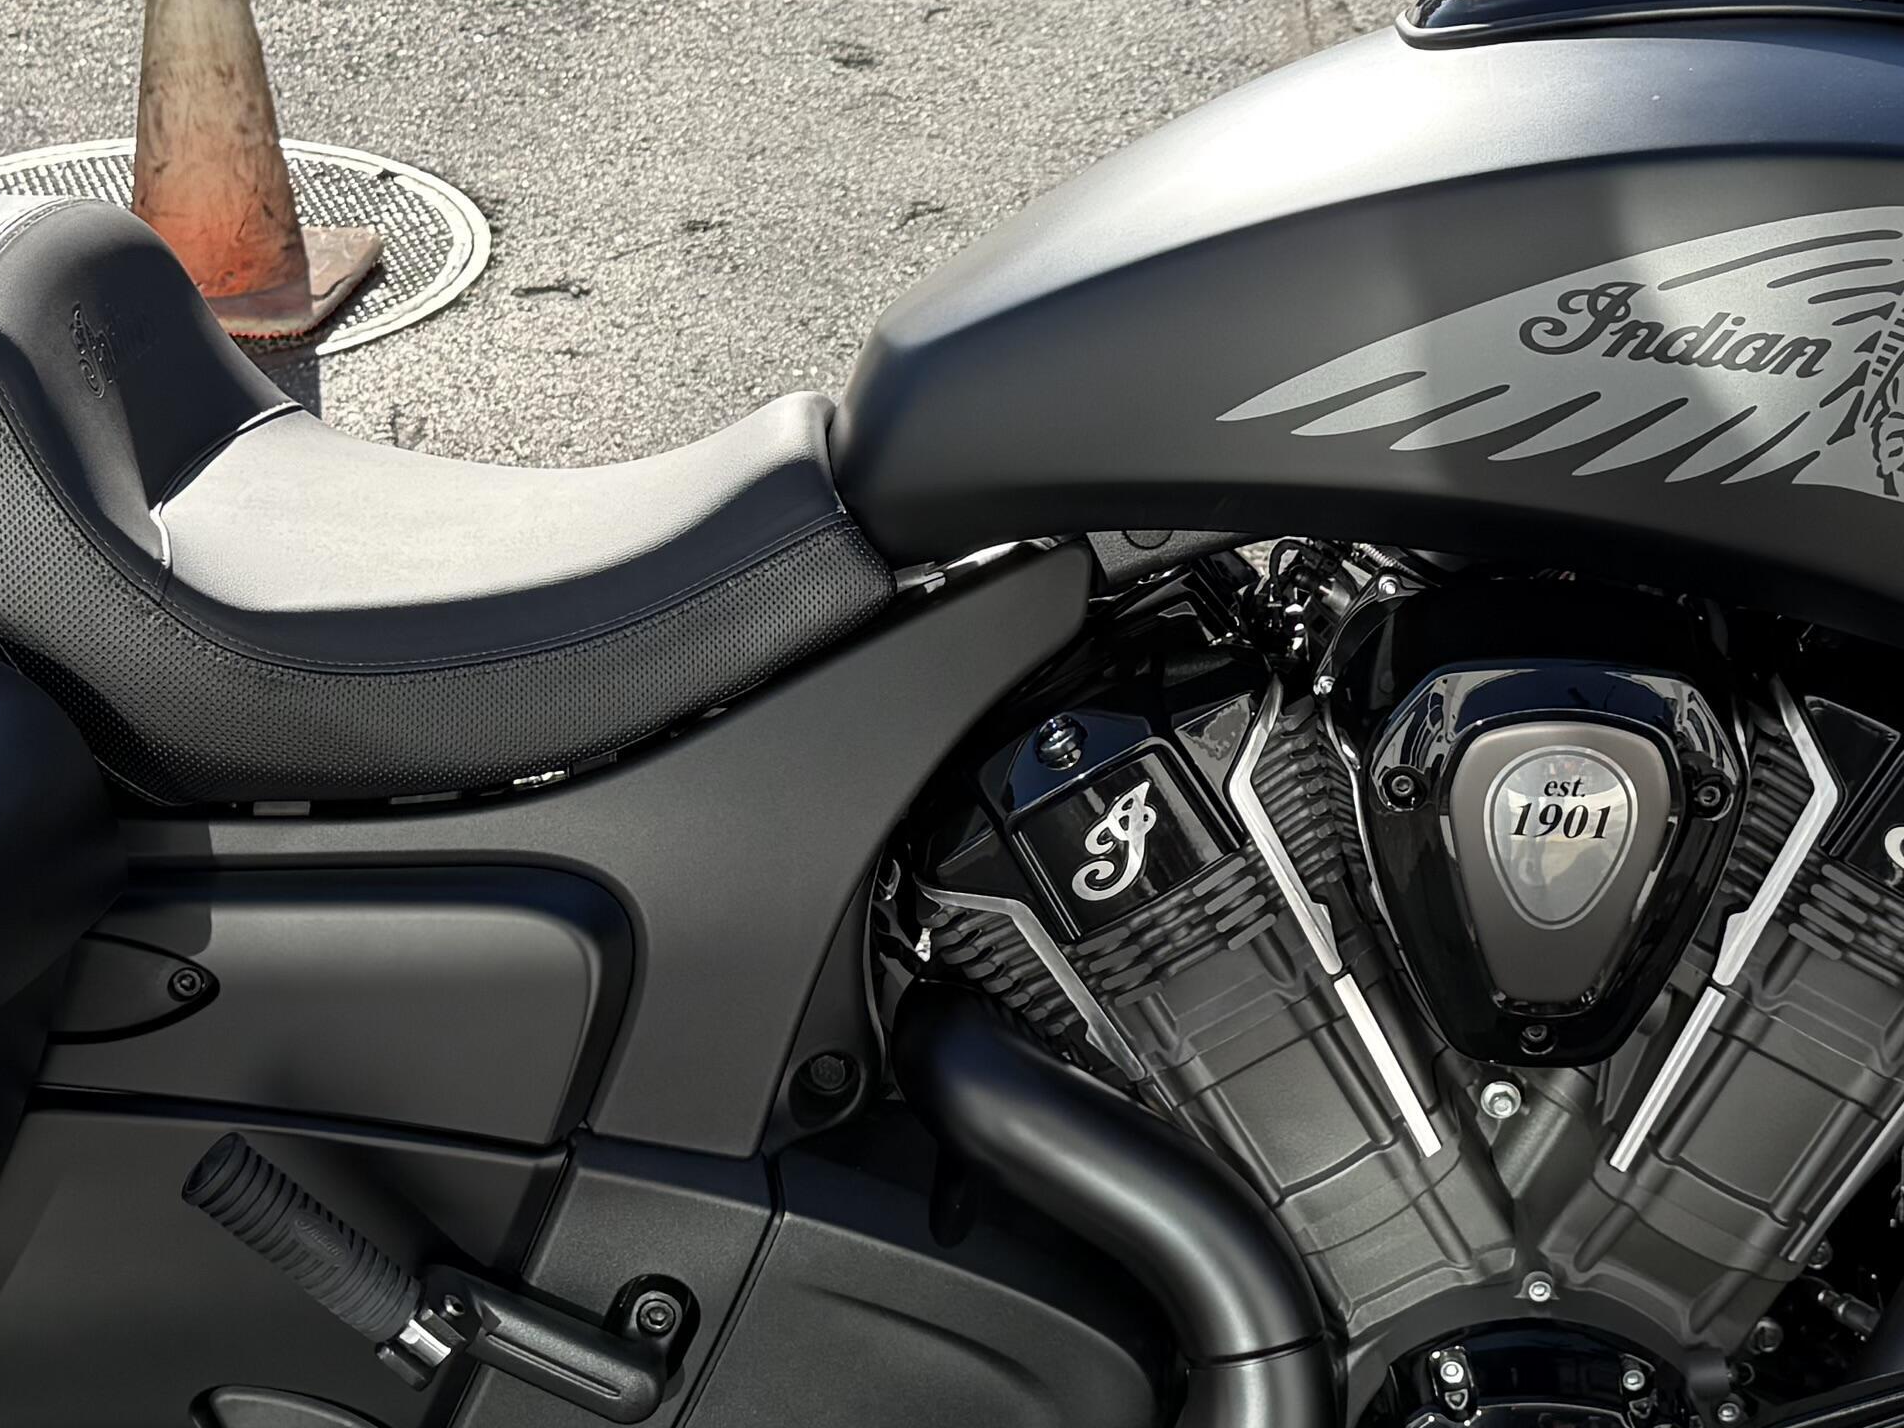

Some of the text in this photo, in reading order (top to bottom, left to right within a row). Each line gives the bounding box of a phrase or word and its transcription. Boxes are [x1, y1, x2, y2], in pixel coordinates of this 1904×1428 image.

[1519, 281, 1832, 378] Indian
[1543, 777, 1586, 798] est.
[1509, 802, 1612, 840] 1901
